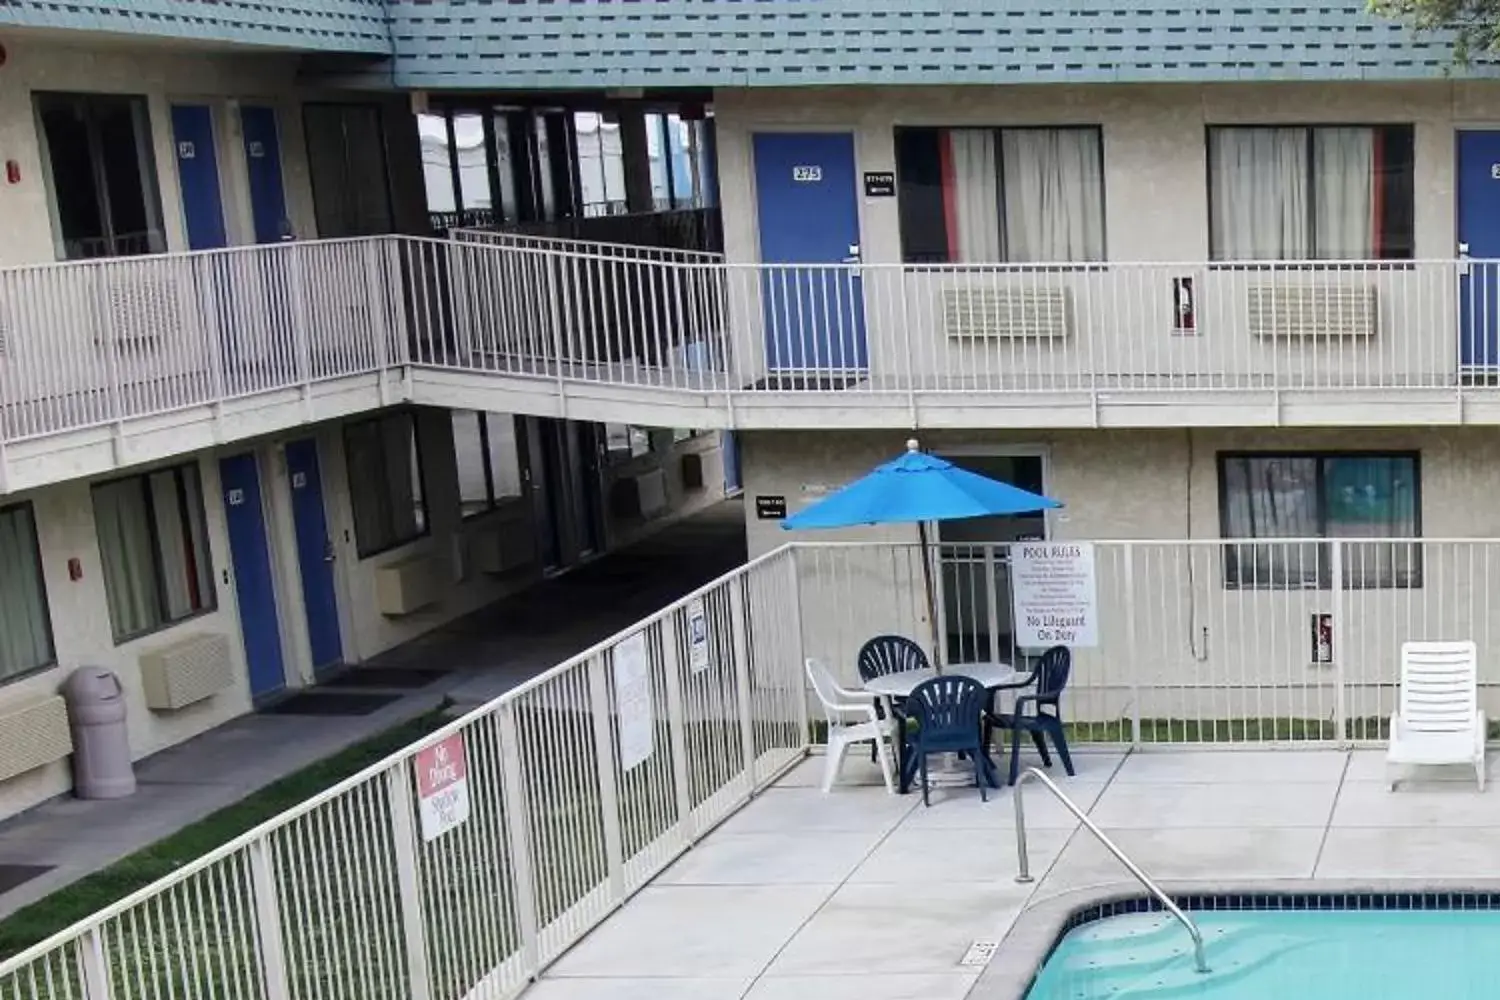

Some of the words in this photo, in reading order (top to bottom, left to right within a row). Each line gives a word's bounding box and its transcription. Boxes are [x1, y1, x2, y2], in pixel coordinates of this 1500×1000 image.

[1023, 547, 1049, 559] POOL
[1051, 546, 1081, 558] RULES
[1027, 615, 1041, 627] No
[1043, 615, 1086, 629] Lifeguard
[1037, 629, 1053, 641] On
[1055, 629, 1076, 642] Duty
